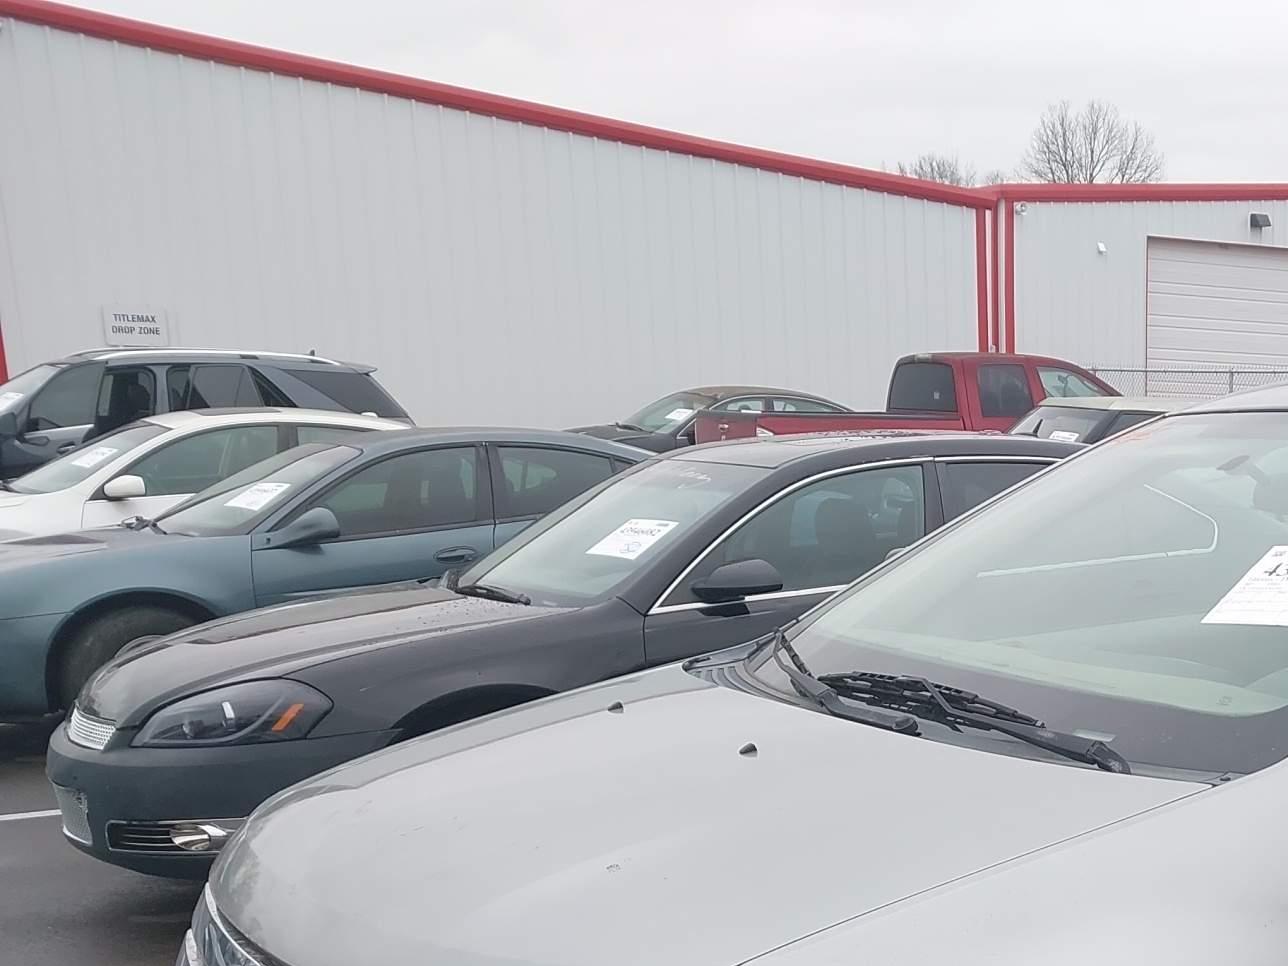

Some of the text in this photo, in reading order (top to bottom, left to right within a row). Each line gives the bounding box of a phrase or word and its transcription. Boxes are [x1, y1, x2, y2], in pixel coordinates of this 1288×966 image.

[111, 313, 157, 323] TITLEMAX
[111, 325, 161, 336] DROP ZONE
